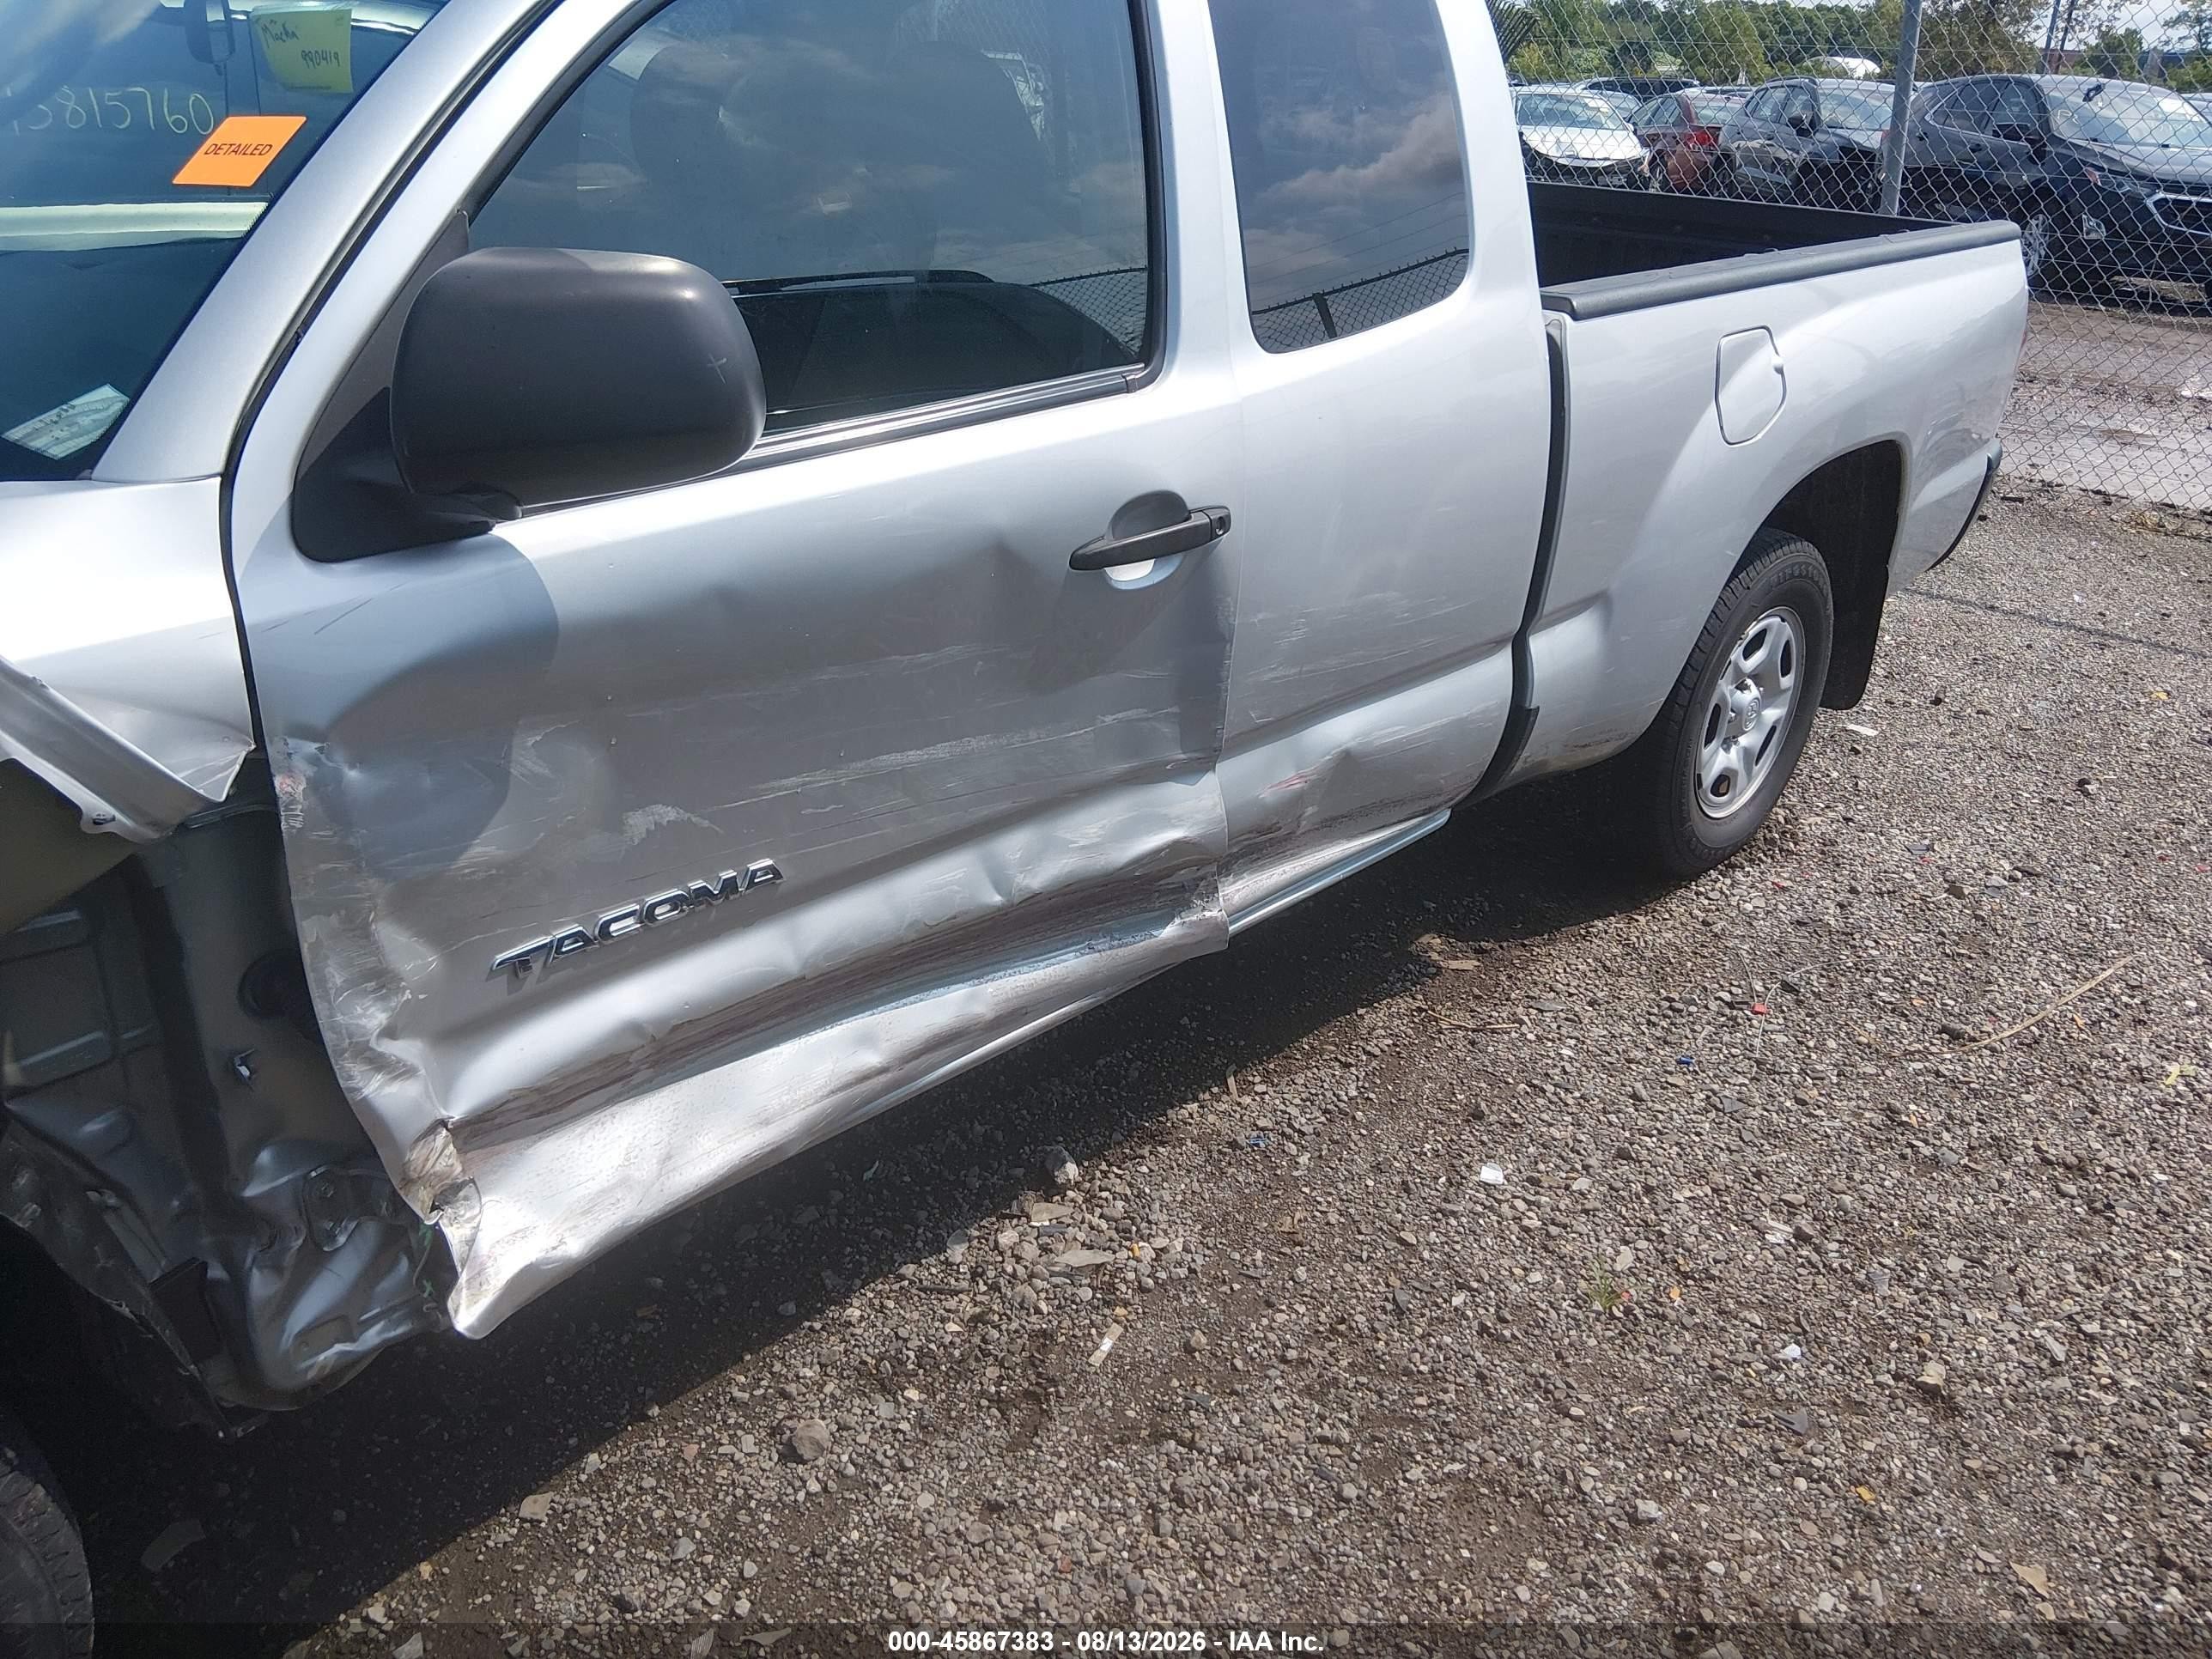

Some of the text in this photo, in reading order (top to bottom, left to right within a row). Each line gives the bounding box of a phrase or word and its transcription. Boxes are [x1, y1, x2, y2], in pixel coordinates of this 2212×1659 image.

[301, 50, 341, 70] 990419
[204, 143, 273, 156] DETAILED
[491, 858, 785, 978] TACOMA
